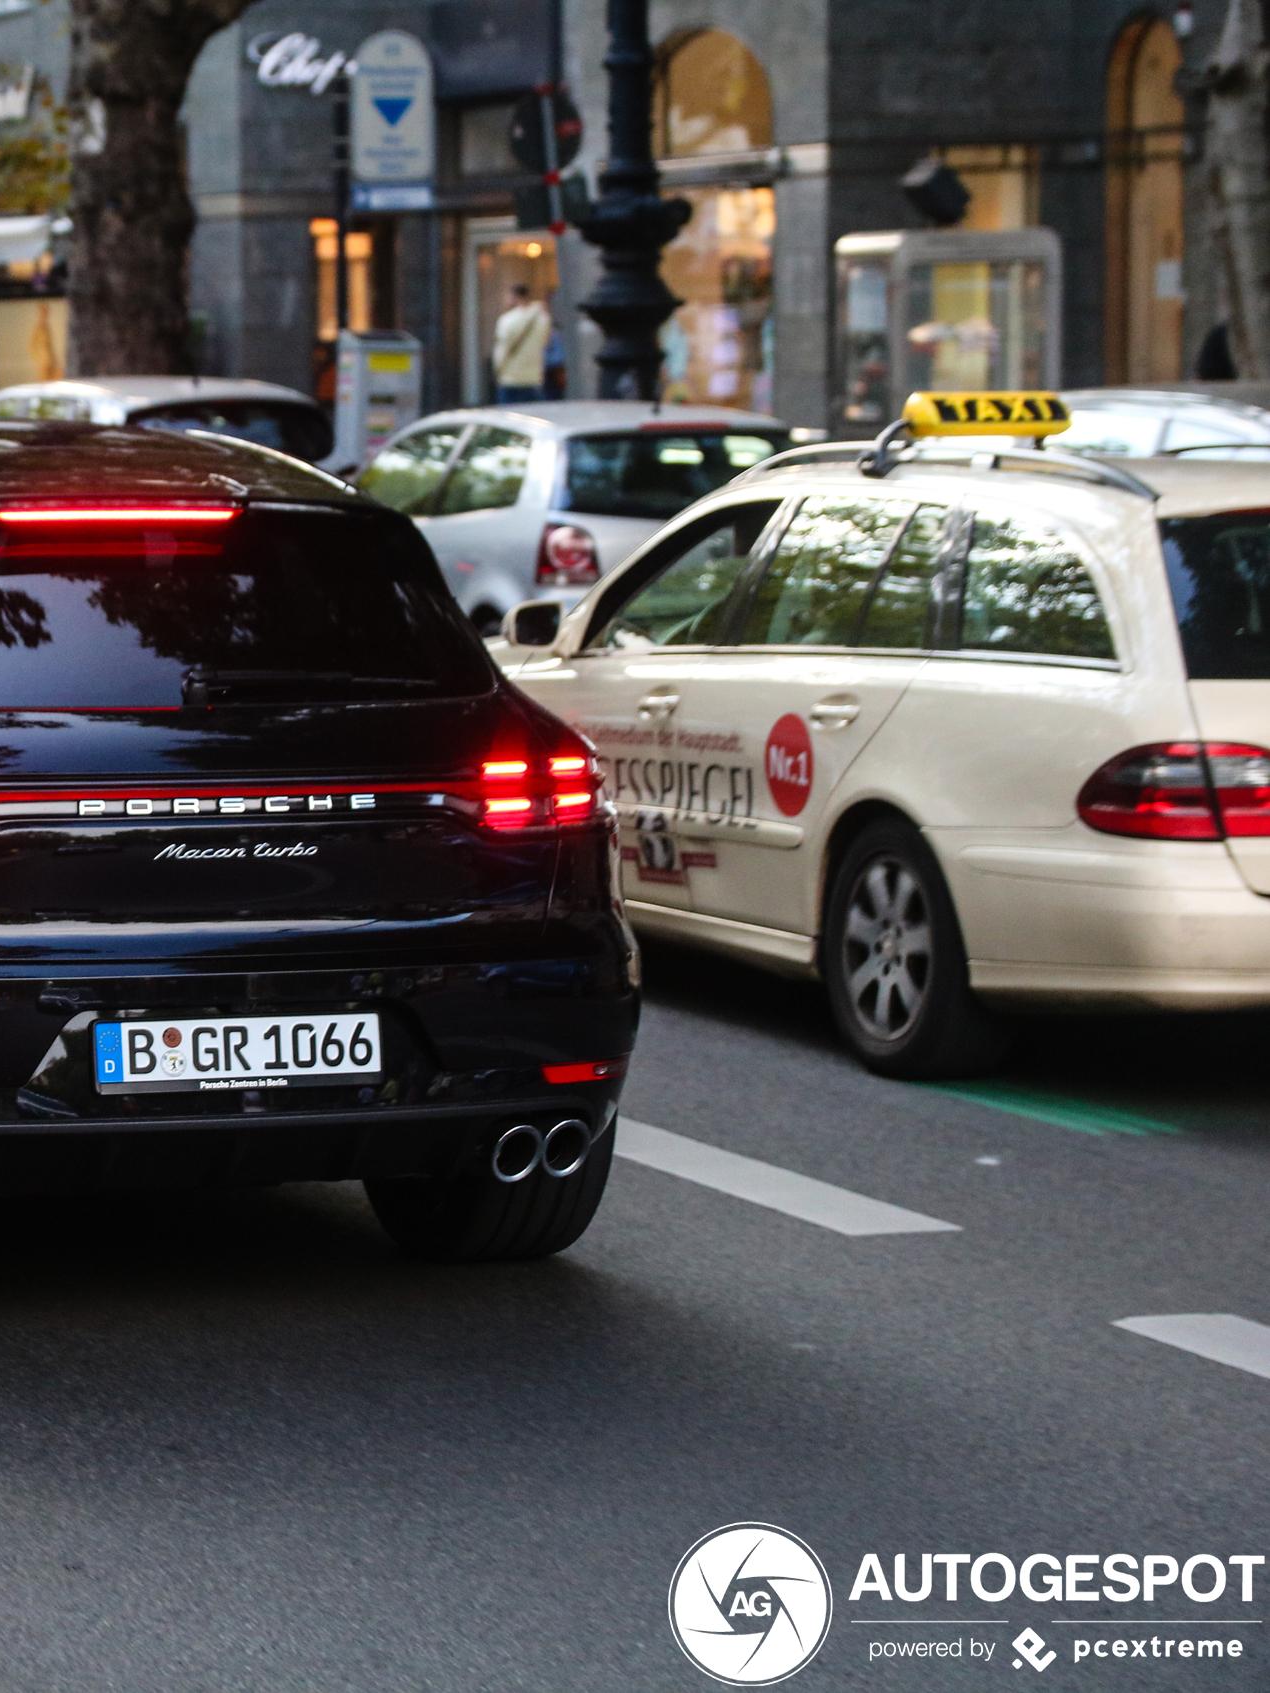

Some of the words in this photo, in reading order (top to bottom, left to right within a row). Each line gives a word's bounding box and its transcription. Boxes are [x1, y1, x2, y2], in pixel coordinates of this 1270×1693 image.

[937, 398, 1061, 422] TAXI
[768, 744, 809, 787] Nr.1
[79, 793, 376, 816] PORSCHE
[153, 842, 246, 861] Macan
[253, 842, 319, 858] turbo
[127, 1028, 158, 1075] B
[191, 1025, 252, 1073] GR
[262, 1021, 374, 1070] 1066
[104, 1060, 116, 1074] D
[199, 1081, 229, 1090] Porsche
[230, 1079, 258, 1088] Zentren
[258, 1078, 266, 1087] in
[266, 1078, 288, 1087] Berlin
